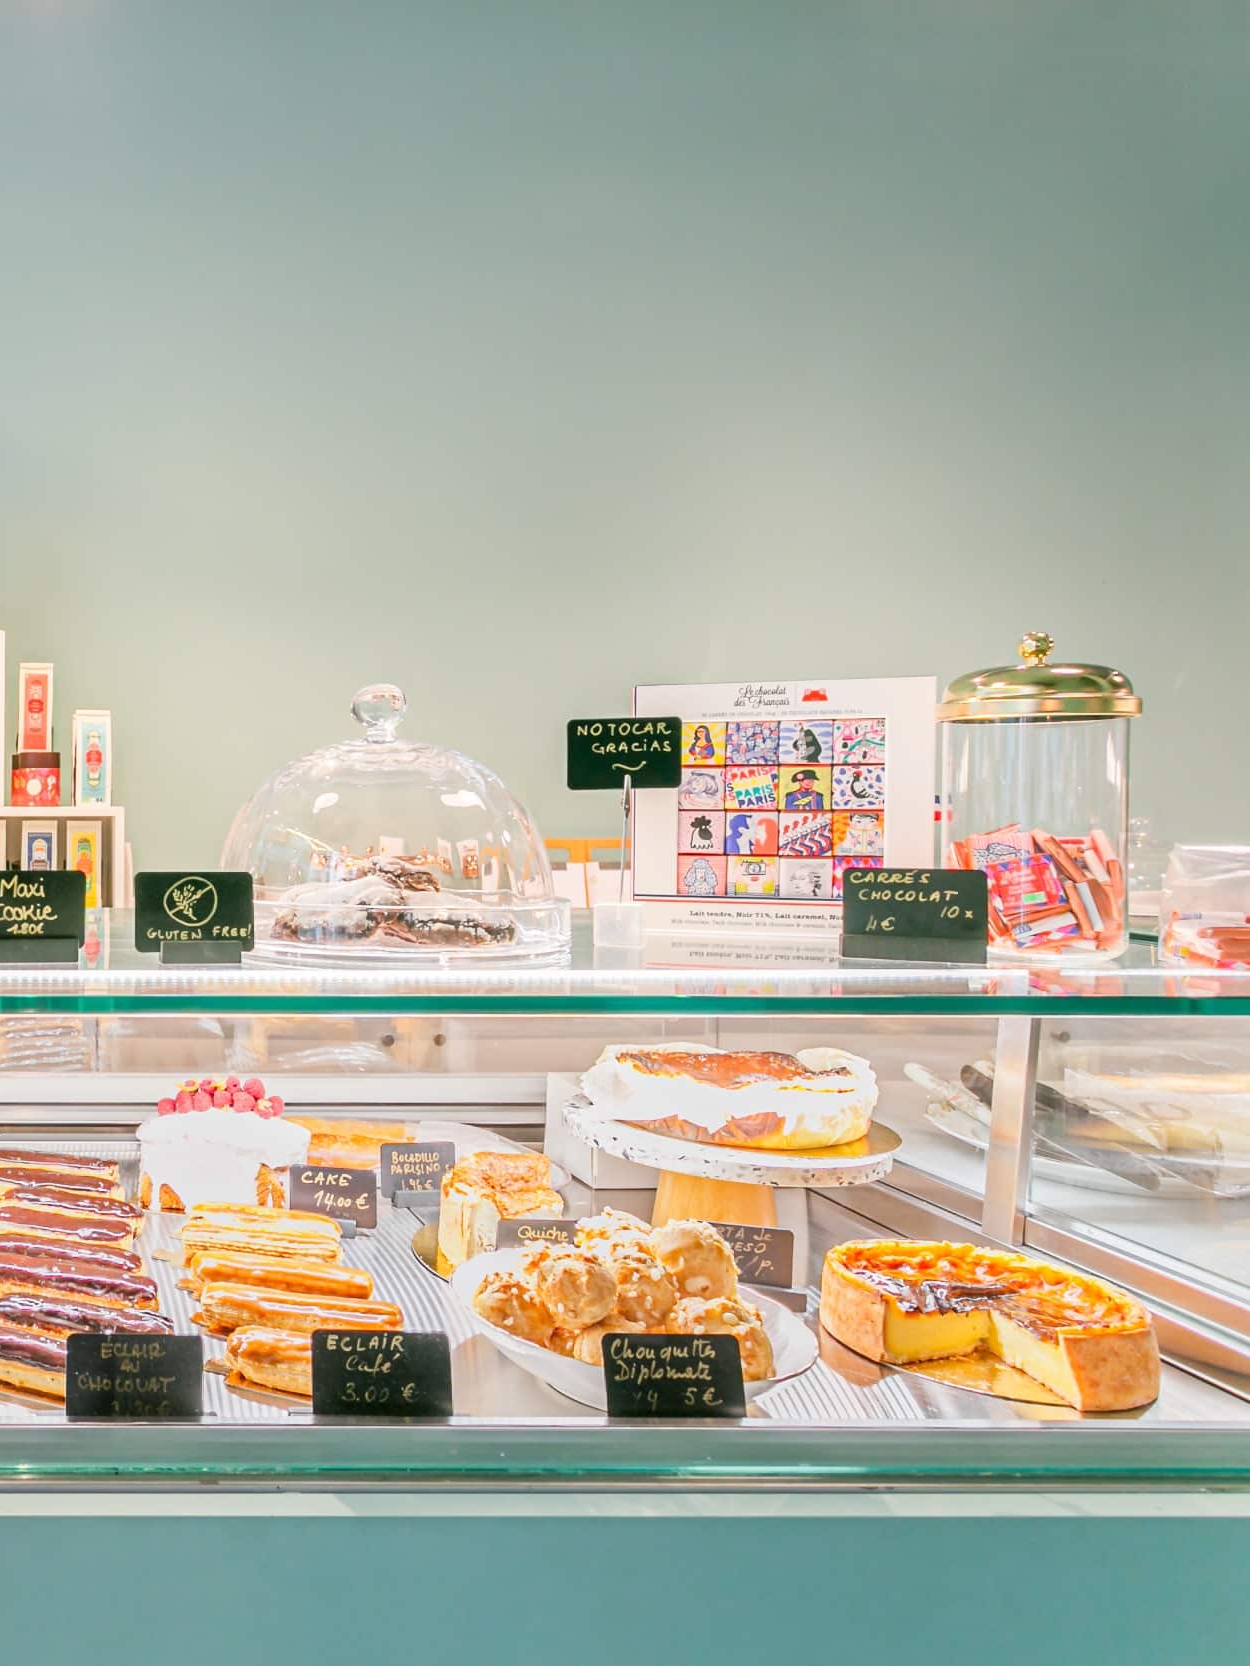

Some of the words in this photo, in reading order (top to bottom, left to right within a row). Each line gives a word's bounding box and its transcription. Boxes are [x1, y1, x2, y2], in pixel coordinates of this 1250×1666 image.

[755, 685, 786, 696] chocolat
[734, 697, 746, 707] des
[749, 695, 790, 709] Français
[577, 723, 603, 736] NO
[607, 722, 672, 737] TOCAR
[731, 767, 768, 781] PARIS
[735, 784, 773, 799] PARIS
[738, 793, 776, 808] PARIS
[850, 870, 930, 884] CARRÉS
[0, 875, 45, 898] Maxi
[858, 889, 958, 902] CHOCOLAT
[147, 928, 202, 940] GLUTEN
[212, 923, 252, 939] FREE!
[301, 1171, 352, 1186] CAKE
[517, 1225, 569, 1241] Quiche
[731, 1241, 767, 1254] ESO
[345, 1353, 401, 1376] Café
[614, 1360, 712, 1385] Diplomate
[400, 1383, 420, 1403] €
